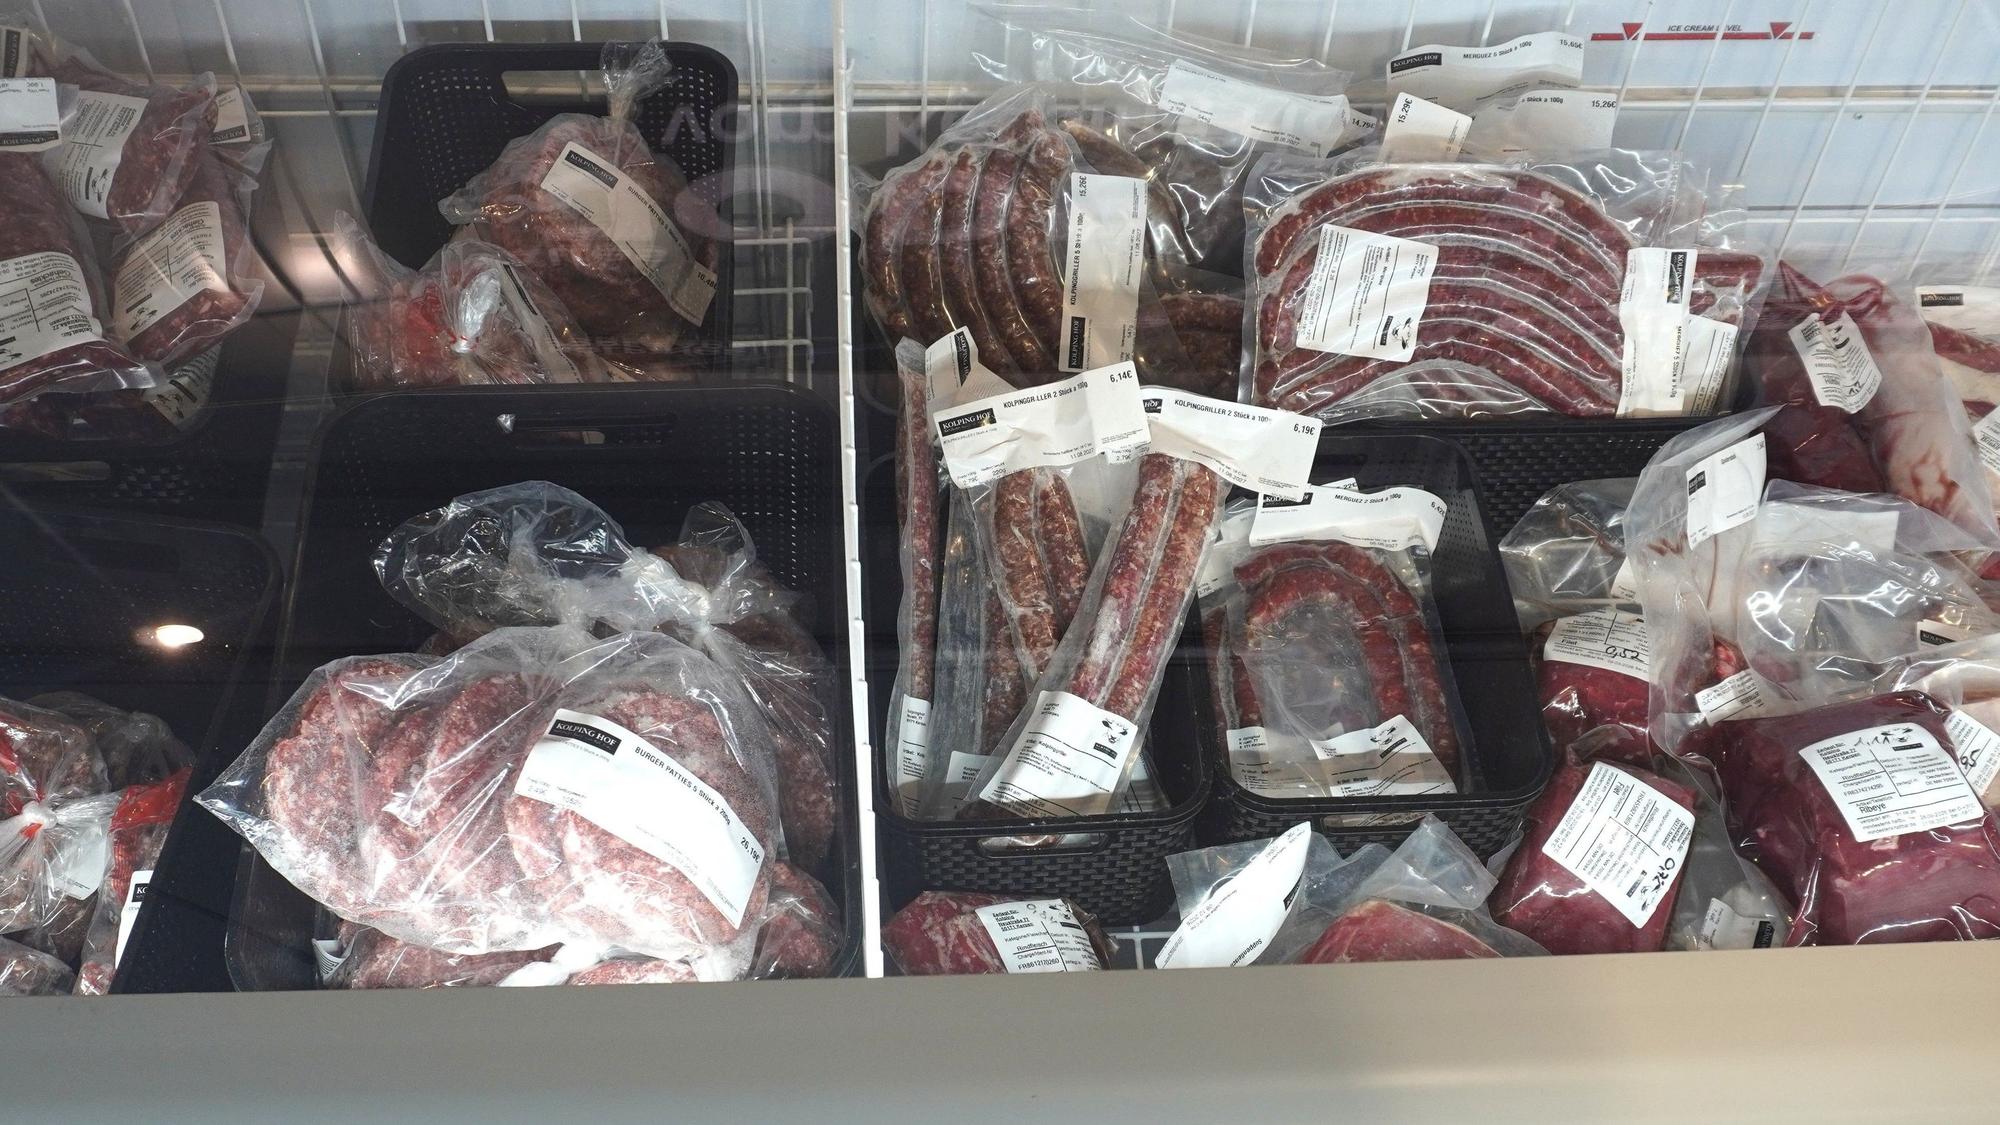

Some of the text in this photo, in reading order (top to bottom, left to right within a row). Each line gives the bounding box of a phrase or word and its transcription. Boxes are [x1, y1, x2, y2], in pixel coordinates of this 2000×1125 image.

[1684, 24, 1714, 32] CREAM
[1715, 24, 1743, 32] LVEL
[1391, 57, 1420, 68] KOLPING
[1549, 96, 1564, 104] 100g
[1591, 100, 1617, 109] 15,26€
[1397, 98, 1413, 124] 15,29€
[1079, 175, 1087, 197] 15,26€
[1070, 255, 1080, 306] KOLPINGGRILLER
[1071, 335, 1079, 368] KOLPING
[1109, 370, 1133, 383] 6,14€
[1003, 391, 1053, 409] KOLPINGGRLLER
[1052, 390, 1058, 398] 2
[1058, 386, 1073, 396] Stück
[1143, 400, 1162, 409] HOF
[1174, 400, 1226, 416] KOLPINGGRILLER
[1226, 408, 1233, 416] 2
[1233, 410, 1251, 421] Stück
[942, 410, 994, 431] KOLPING HOF
[1293, 423, 1316, 436] 6,19€
[1334, 494, 1363, 504] MERGUEZ
[555, 722, 617, 747] KOLPING HOF
[634, 746, 665, 769] BURGER
[665, 764, 693, 789] PATTIES
[692, 784, 698, 792] 5
[698, 789, 715, 807] Stück
[1611, 780, 1625, 796] Filet
[1859, 802, 1886, 814] Ribeye
[740, 836, 761, 864] 26,19€
[1015, 940, 1047, 951] Rindfleisch
